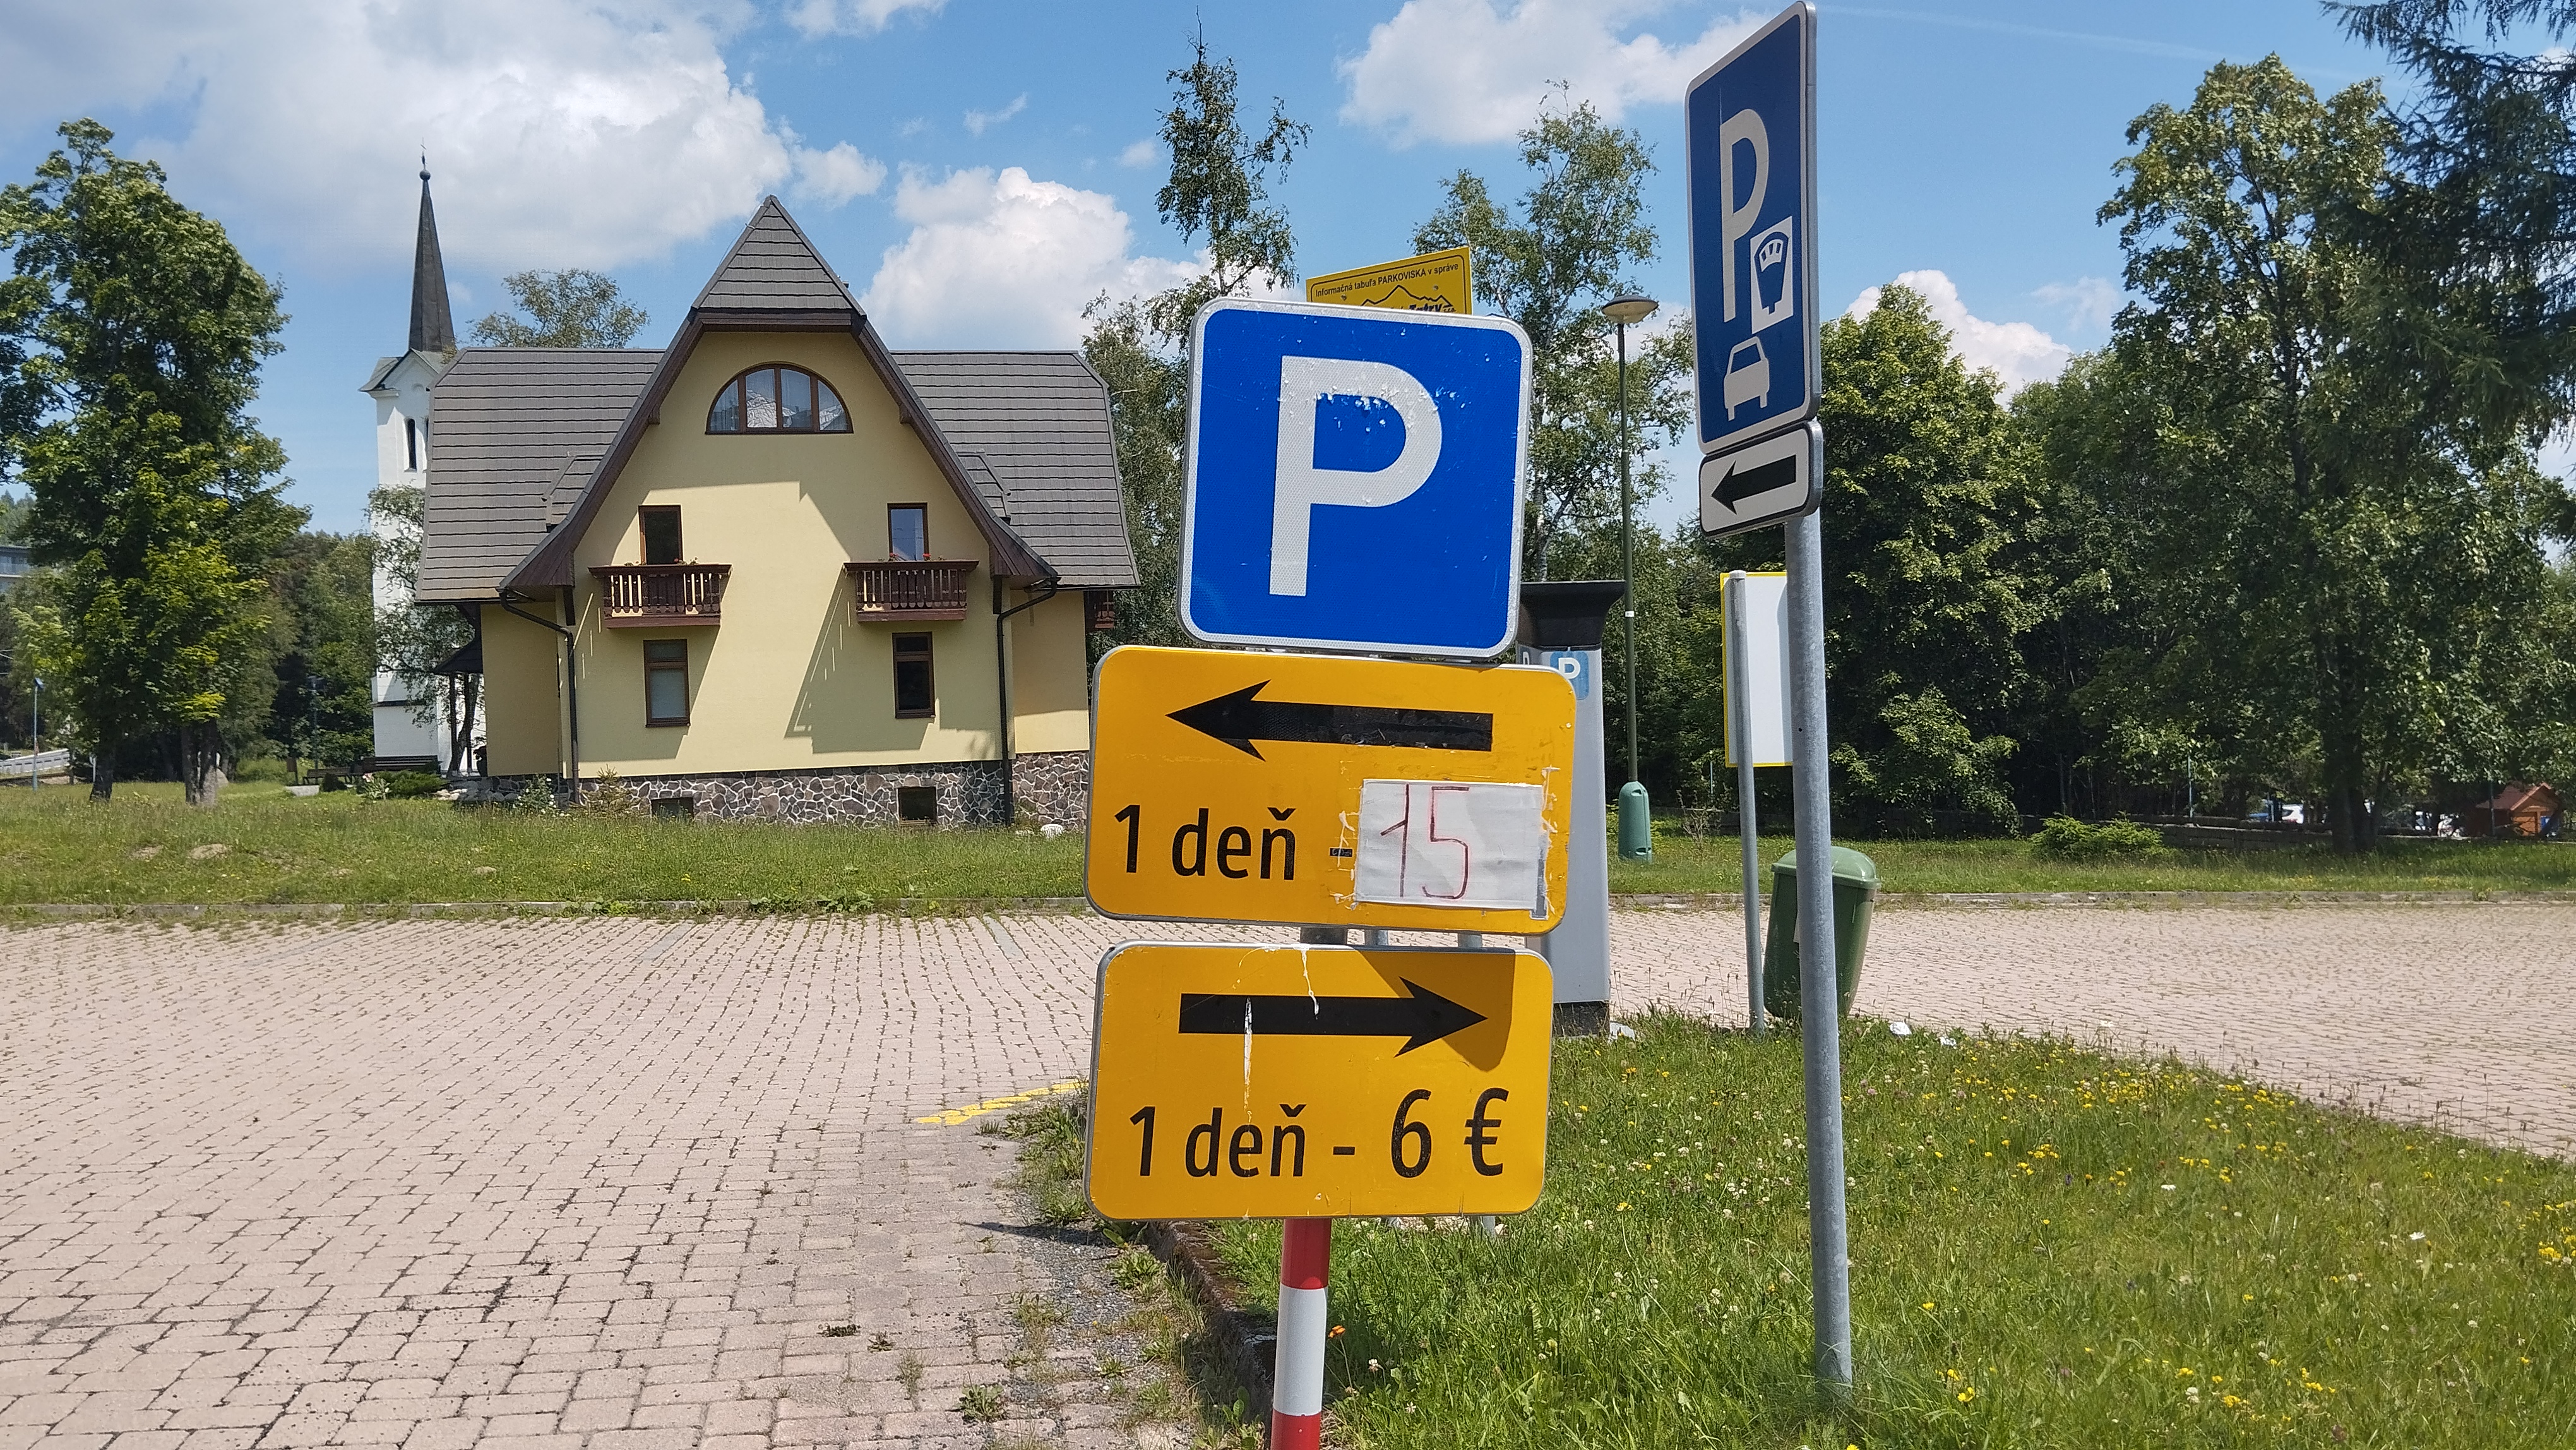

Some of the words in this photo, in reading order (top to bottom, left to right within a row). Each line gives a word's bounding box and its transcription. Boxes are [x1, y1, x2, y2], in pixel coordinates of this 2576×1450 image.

[1719, 108, 1769, 323] P
[1315, 282, 1353, 297] Informačná
[1354, 279, 1376, 289] tabuľa
[1378, 268, 1426, 285] PARKOVISKA
[1434, 263, 1458, 275] správe
[1269, 355, 1442, 597] P
[1114, 805, 1141, 873] 1
[1171, 806, 1296, 881] deň
[1380, 783, 1470, 899] 15
[1130, 1106, 1156, 1177] 1
[1184, 1104, 1307, 1178] deň
[1391, 1088, 1432, 1178] 6
[1464, 1088, 1510, 1177] €
